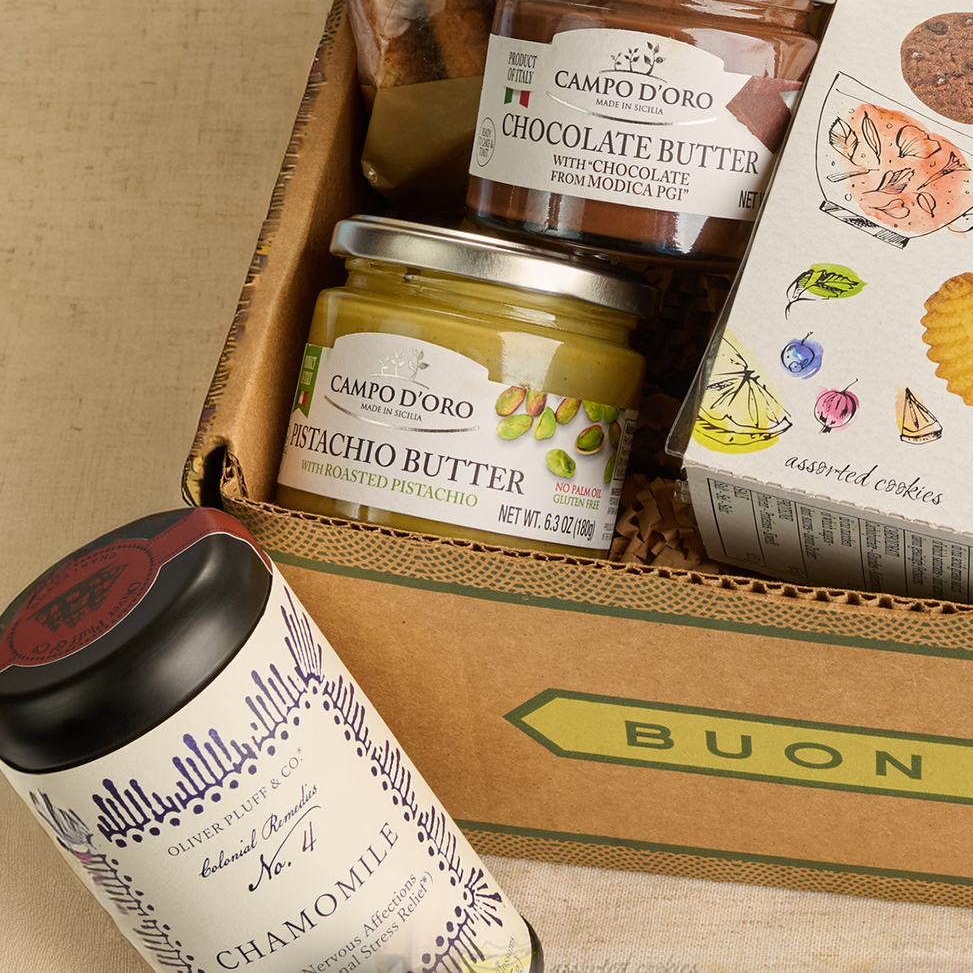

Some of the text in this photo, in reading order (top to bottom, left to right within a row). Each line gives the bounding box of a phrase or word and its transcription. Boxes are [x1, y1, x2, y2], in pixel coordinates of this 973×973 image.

[507, 67, 534, 85] OF ITALY
[508, 51, 538, 69] PRODUCT
[554, 69, 634, 99] CAMPO
[595, 98, 664, 116] MADE IN SICILIA
[502, 112, 652, 161] CHOCOLATE
[656, 138, 759, 175] BUTTER
[552, 154, 586, 171] WITH
[550, 170, 585, 186] FROM
[588, 176, 652, 197] MODICA
[739, 190, 758, 209] NET
[330, 374, 396, 406] CAMPO
[360, 402, 423, 422] MADE IN SICILIA
[289, 422, 396, 468] PISTACHIO
[401, 447, 525, 496] BUTTER
[301, 459, 478, 508] WITH ROASTED PISTACHIO
[555, 482, 602, 499] NO PALM OIL
[784, 456, 944, 506] assorted cookies
[552, 493, 600, 510] GLUTEN FREE
[498, 504, 521, 525] NET
[522, 509, 541, 530] WT.
[544, 513, 560, 532] 6.3
[561, 515, 574, 534] OZ
[624, 719, 922, 781] BUON
[167, 822, 224, 857] OLIVER
[223, 786, 268, 827] PLUFF
[270, 778, 281, 789] &
[199, 783, 318, 878] Colonial Remedies
[302, 821, 317, 853] 4
[216, 822, 399, 970] CHAMOMILE
[302, 873, 417, 973] Nervous Affections
[360, 923, 399, 959] Stress
